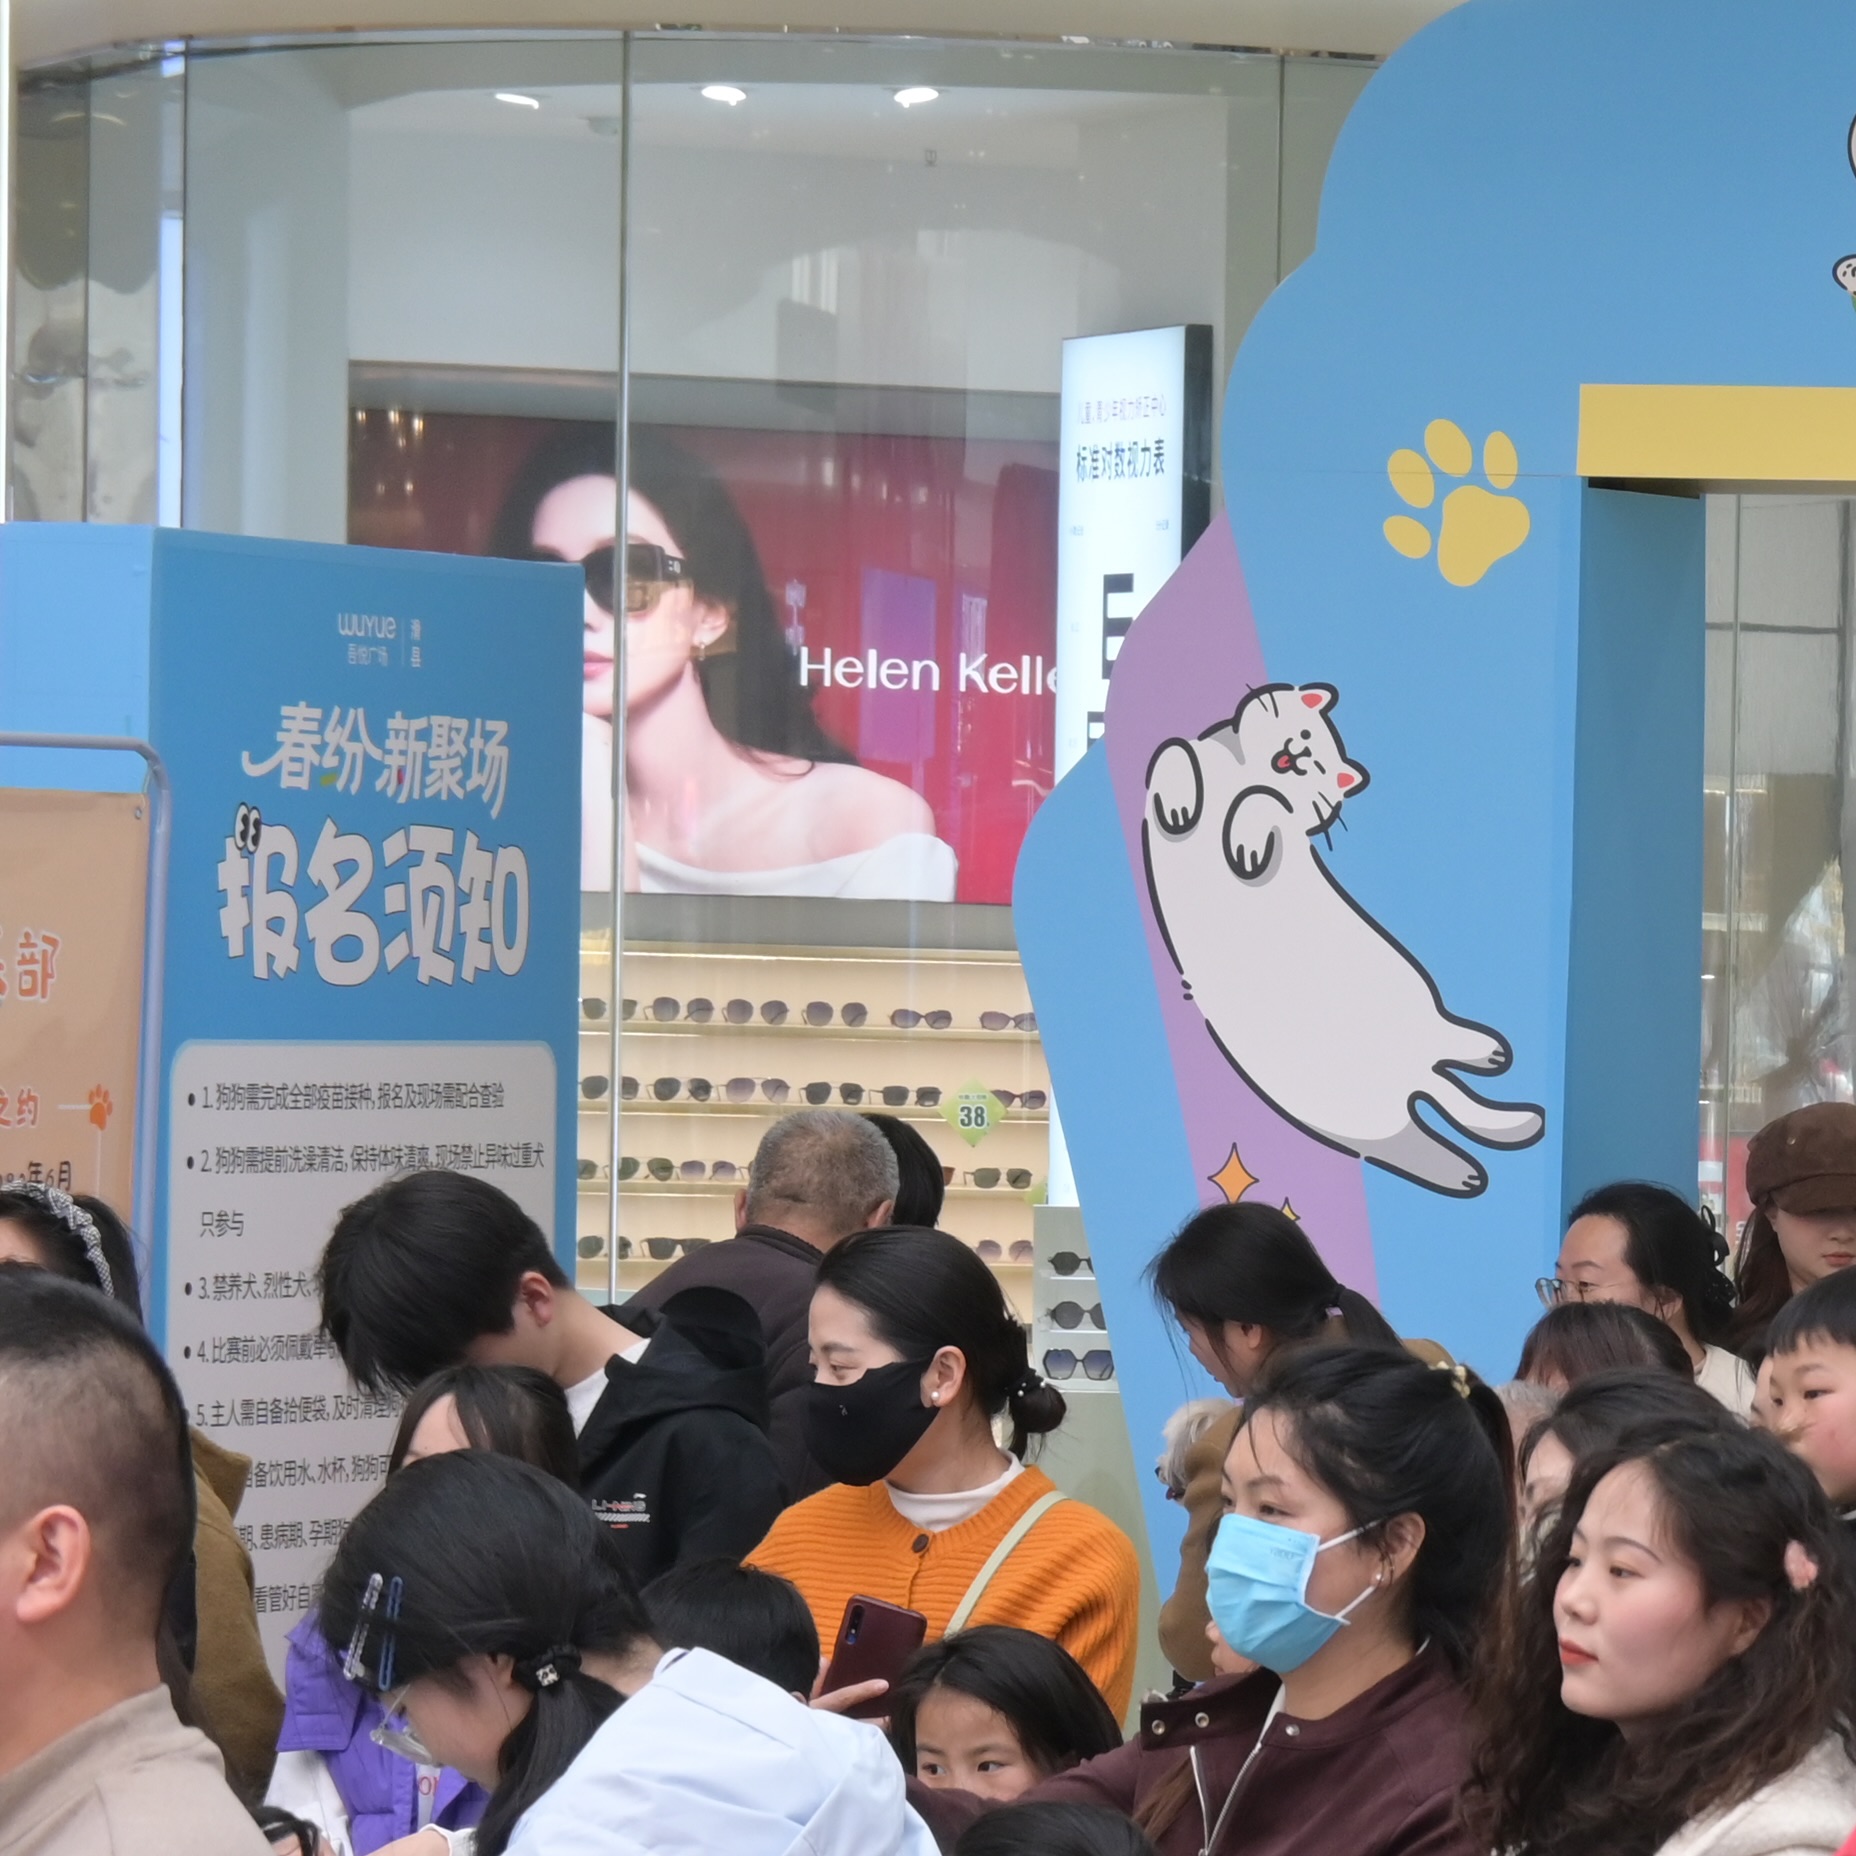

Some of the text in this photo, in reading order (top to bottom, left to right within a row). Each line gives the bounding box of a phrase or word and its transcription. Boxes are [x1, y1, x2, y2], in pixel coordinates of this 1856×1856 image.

[1077, 437, 1164, 482] 标准对数视力表
[799, 646, 1057, 696] Helen Kell
[241, 701, 511, 820] 春纷新聚场
[216, 816, 529, 987] 报名须知
[0, 931, 60, 999] 部
[199, 1211, 245, 1239] 只参与
